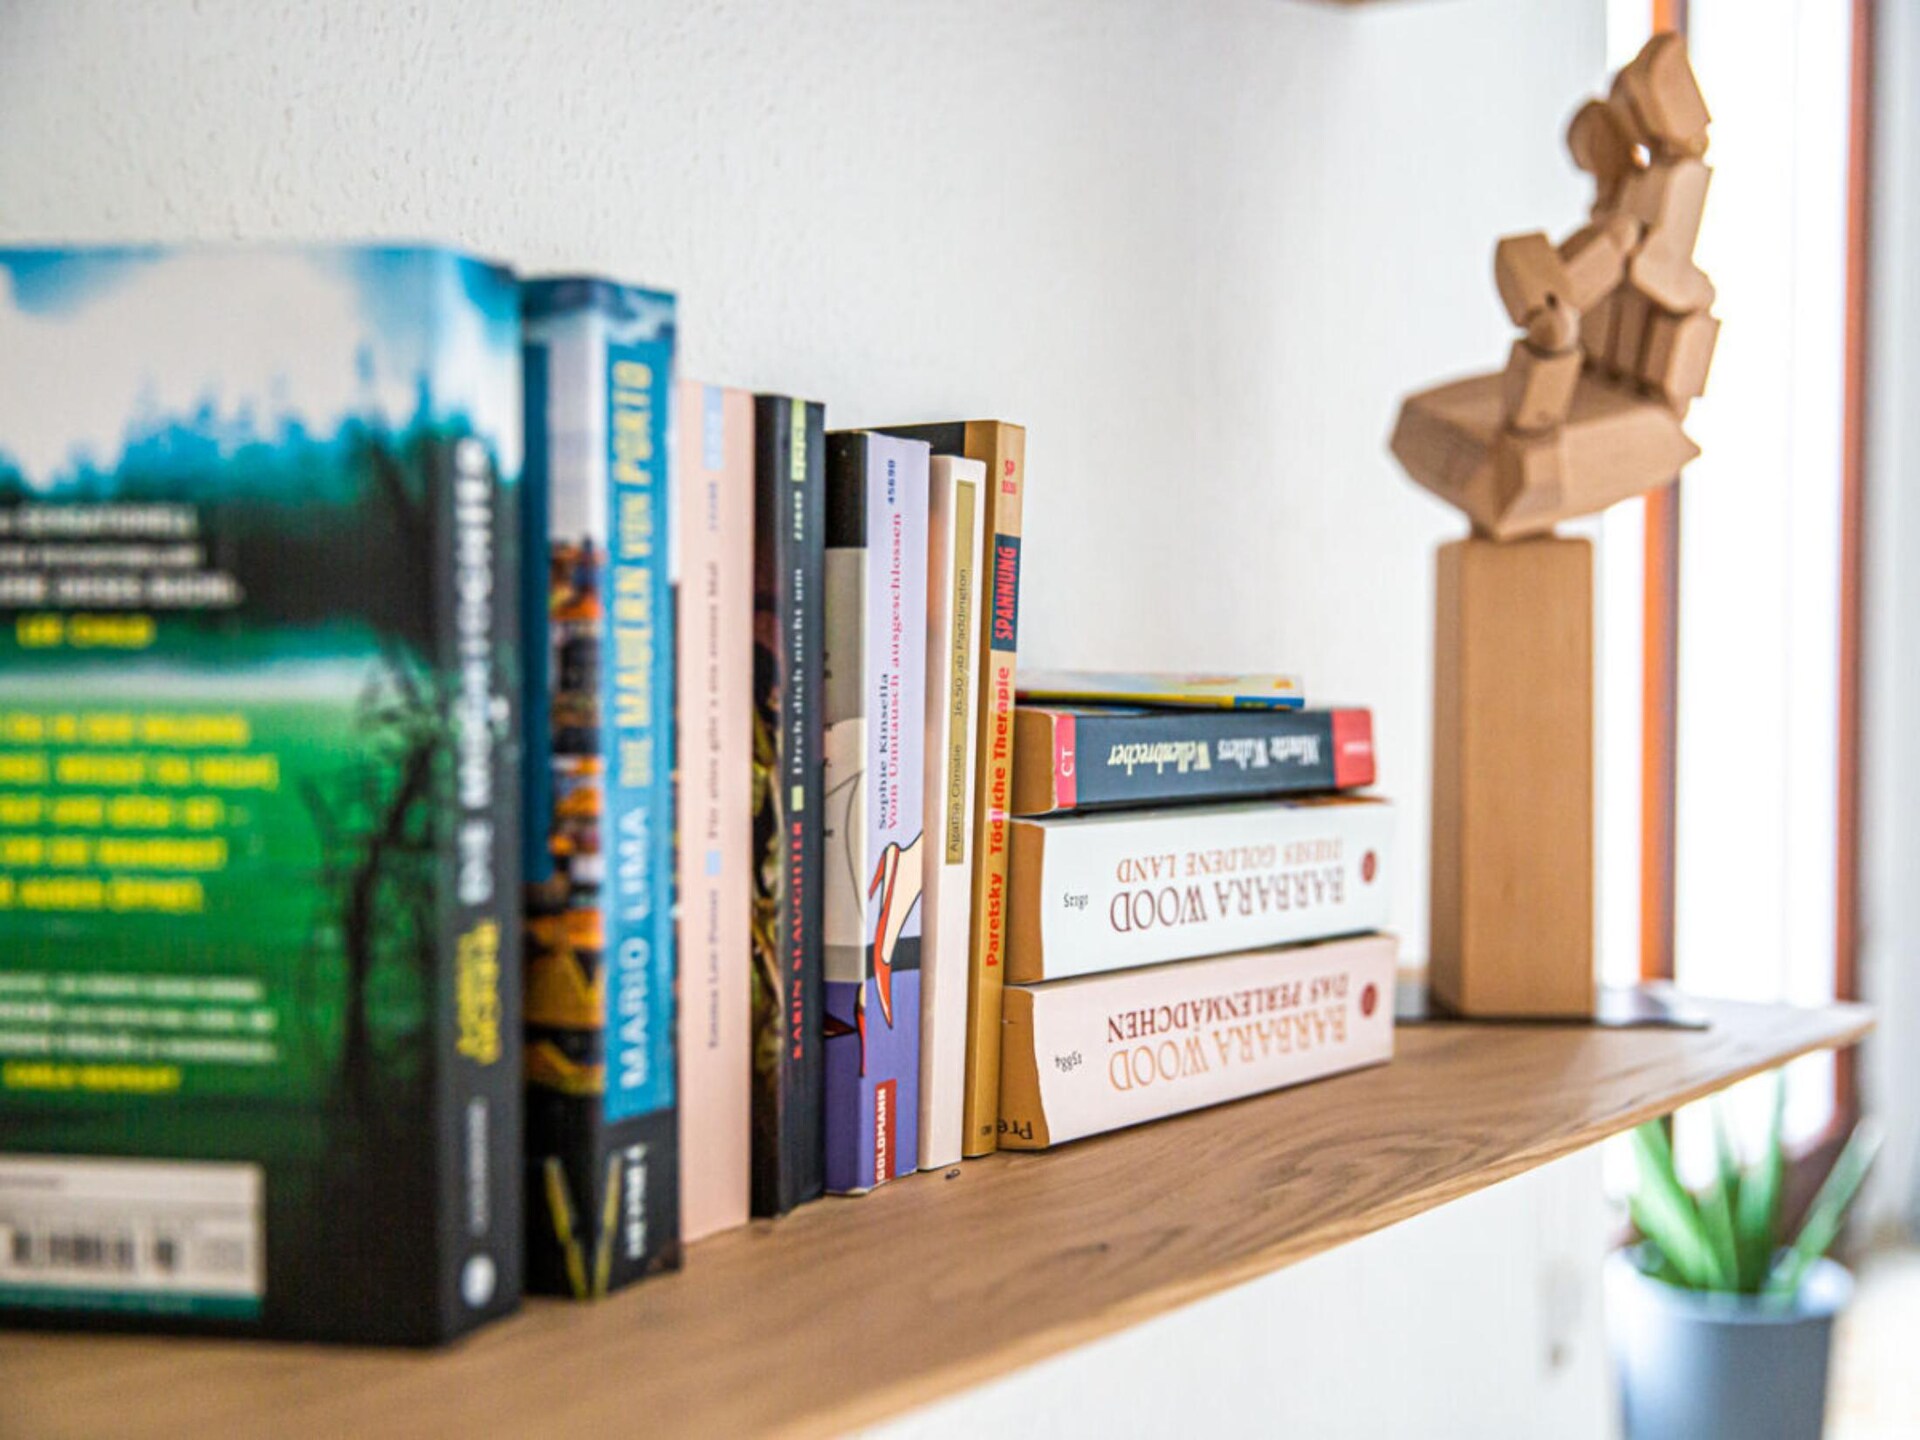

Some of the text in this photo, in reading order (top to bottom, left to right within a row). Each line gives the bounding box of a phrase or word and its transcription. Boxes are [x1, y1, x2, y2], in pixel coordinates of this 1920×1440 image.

[612, 360, 653, 485] PORTO
[956, 568, 968, 650] Paddington
[995, 546, 1018, 641] SPANNUNG
[614, 565, 652, 727] MAUERN
[792, 568, 803, 775] Dreh dich nicht um
[887, 513, 903, 830] Vom Umtausch ausgeschlossen
[955, 655, 965, 673] ab
[879, 673, 889, 830] Sophie Kinsella
[949, 744, 962, 852] Agatha Christie
[1107, 740, 1212, 777] Wellenbrecher
[1217, 737, 1269, 771] Walters
[985, 667, 1009, 967] Paretsky Tödliche Therapie
[1116, 837, 1344, 884] DIESES GOLDENE LAND
[791, 822, 803, 1061] KARIN SLAUGHTER
[1063, 892, 1089, 913] 18125
[1109, 866, 1345, 933] BARBARA WOOD
[618, 807, 649, 1090] MARIO LIMA
[1107, 972, 1350, 1043] DAS PERLENMÄDCHEN
[1108, 1003, 1347, 1092] BARBARA WOOD
[876, 1087, 886, 1181] GOLDMANN
